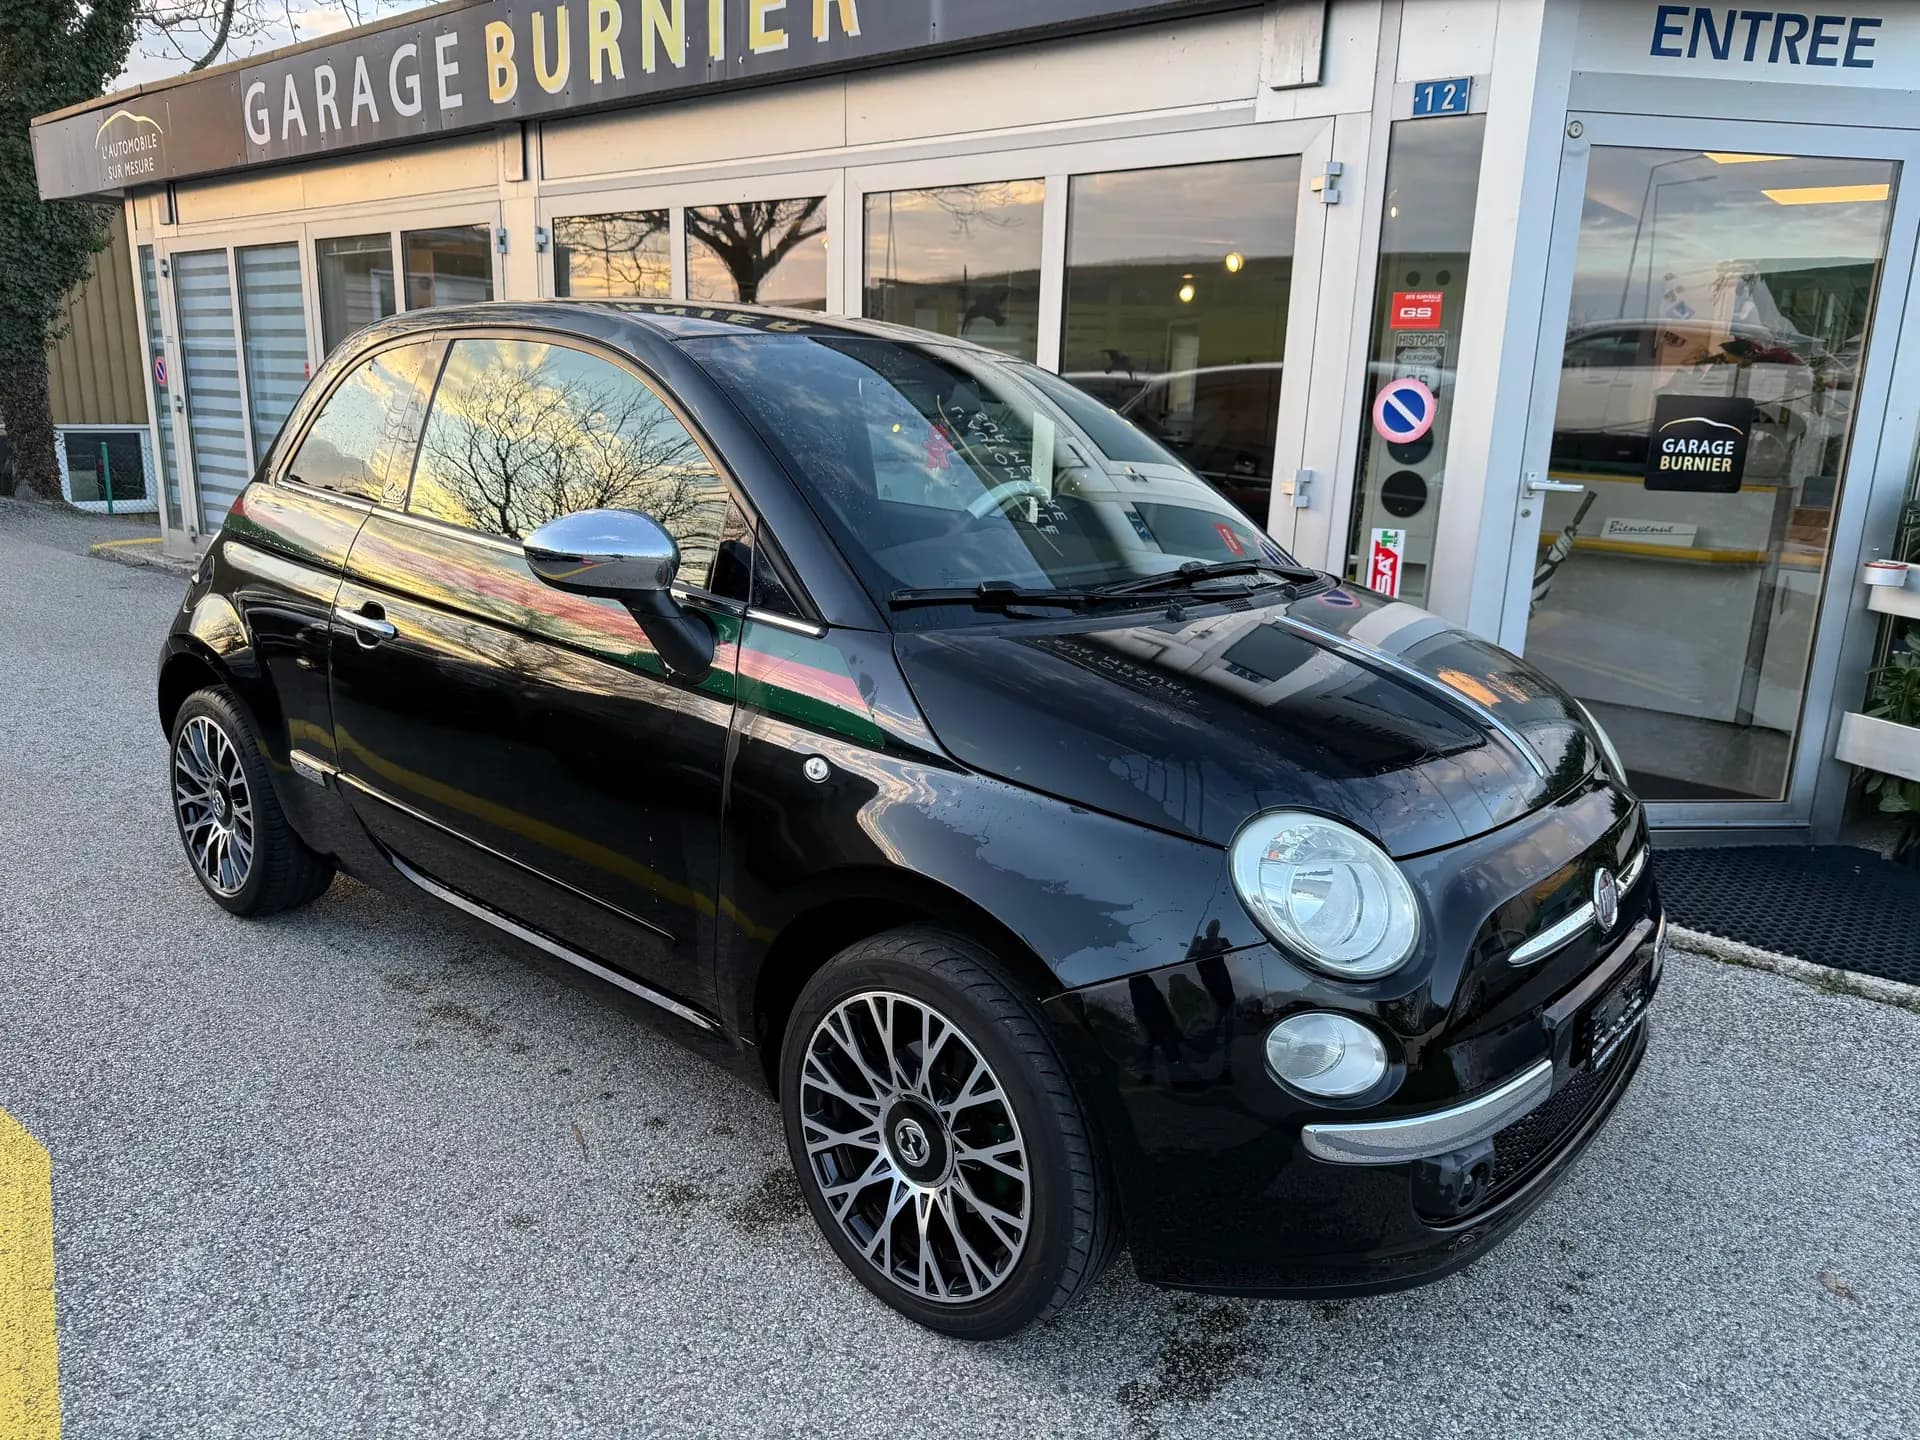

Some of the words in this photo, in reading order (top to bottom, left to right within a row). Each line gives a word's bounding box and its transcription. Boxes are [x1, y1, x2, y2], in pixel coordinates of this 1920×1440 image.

[1650, 5, 1883, 68] ENTREE
[244, 31, 463, 145] GARAGE
[1424, 83, 1456, 111] 12
[101, 133, 157, 160] L'AUTOMOBILE
[108, 163, 123, 180] SUR
[124, 156, 154, 177] MESURE
[1400, 307, 1432, 318] GS
[1399, 334, 1445, 346] HISTORIC
[1662, 438, 1735, 455] GARAGE
[1659, 455, 1732, 472] BURNIER
